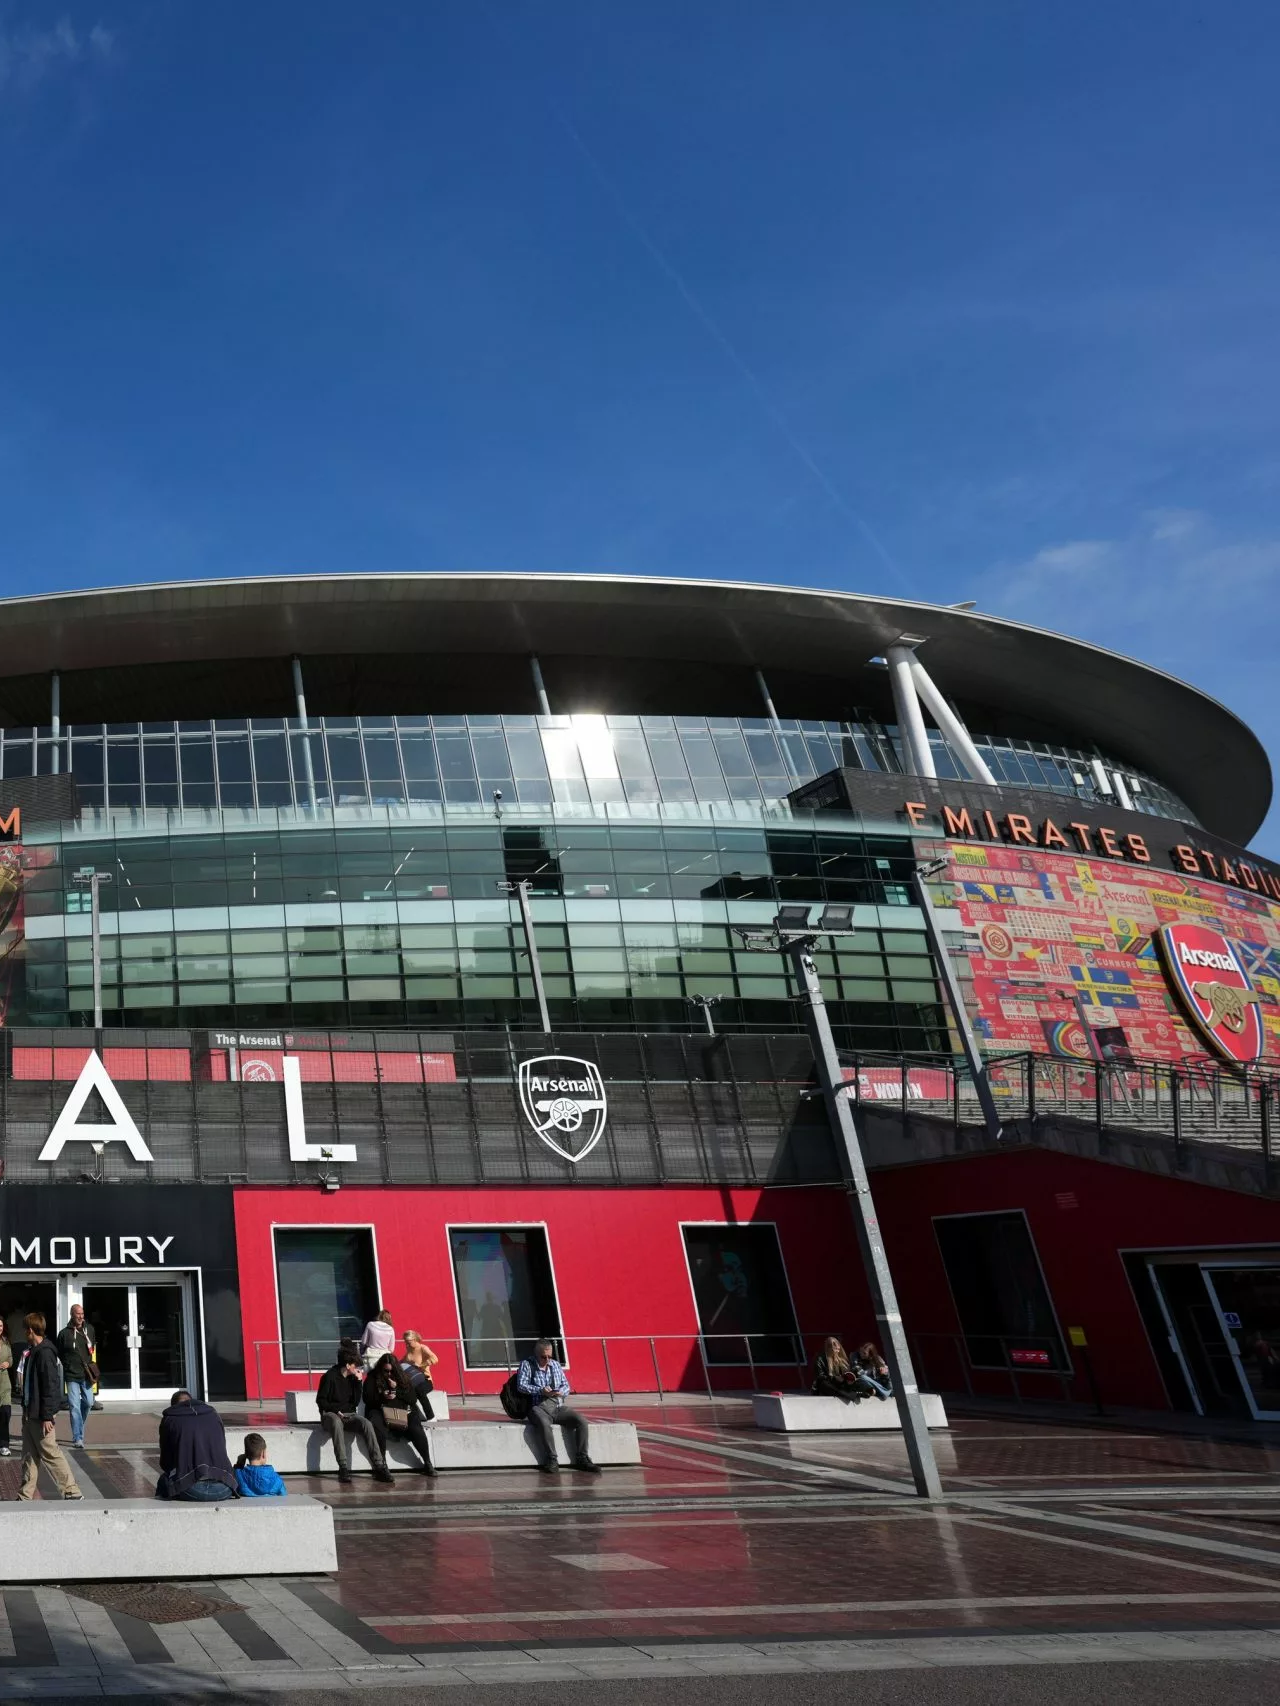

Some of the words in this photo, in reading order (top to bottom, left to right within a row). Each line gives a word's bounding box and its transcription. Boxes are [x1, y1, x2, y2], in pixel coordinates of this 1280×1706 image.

[904, 801, 1151, 862] EMIRATES
[1101, 884, 1151, 906] Arsenal
[1096, 957, 1138, 969] GUNNERS
[1179, 942, 1239, 972] Arsenal
[215, 1034, 236, 1045] The
[239, 1034, 282, 1046] Arsenal
[531, 1076, 594, 1092] Arsenal
